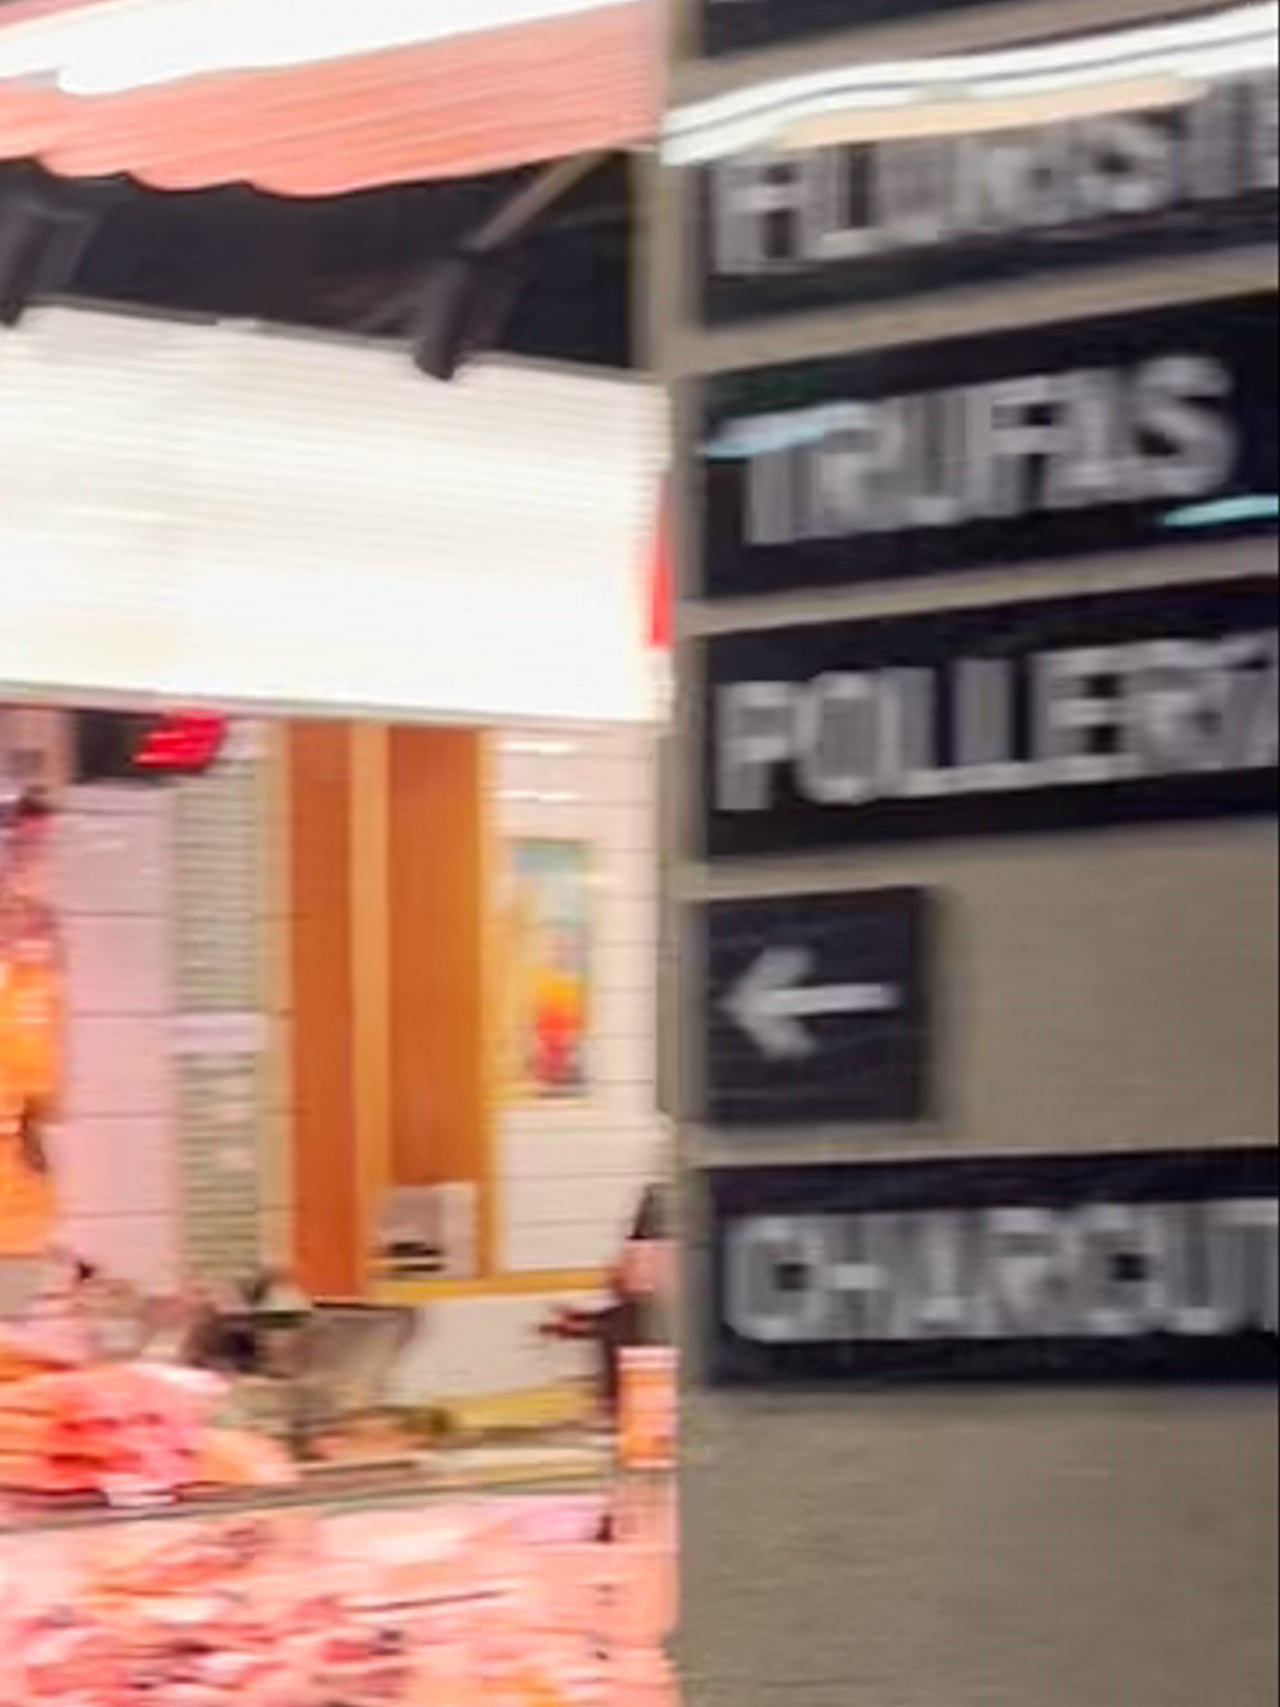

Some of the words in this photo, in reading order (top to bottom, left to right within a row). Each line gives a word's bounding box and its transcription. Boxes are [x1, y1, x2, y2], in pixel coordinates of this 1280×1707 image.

[714, 67, 1278, 274] FLORIST
[716, 355, 1235, 544] TRUFAS
[724, 1198, 1278, 1343] CHARCUT
